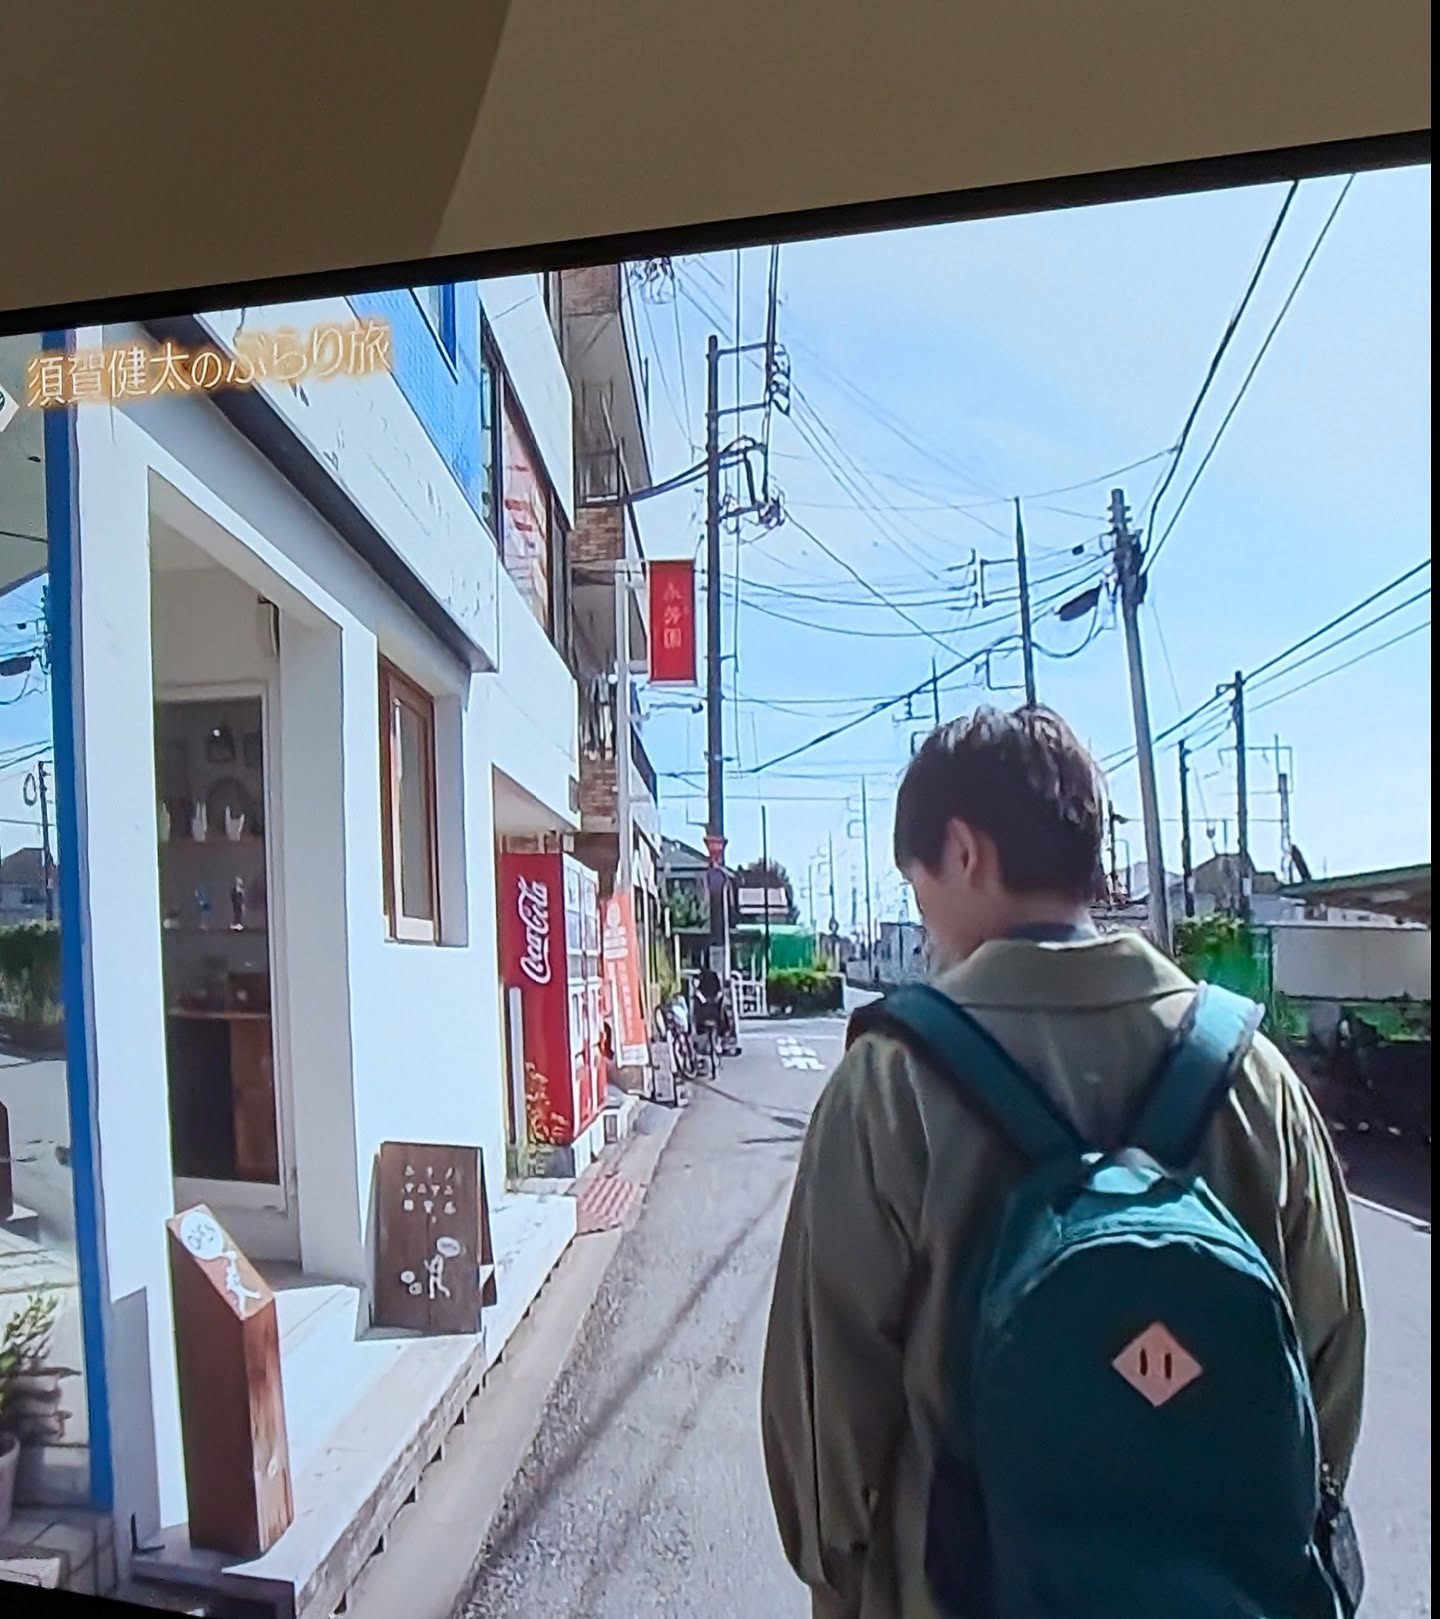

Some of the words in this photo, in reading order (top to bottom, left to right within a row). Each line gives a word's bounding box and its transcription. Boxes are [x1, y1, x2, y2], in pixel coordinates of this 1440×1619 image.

[27, 319, 392, 408] 須賀健太のぶらり旅
